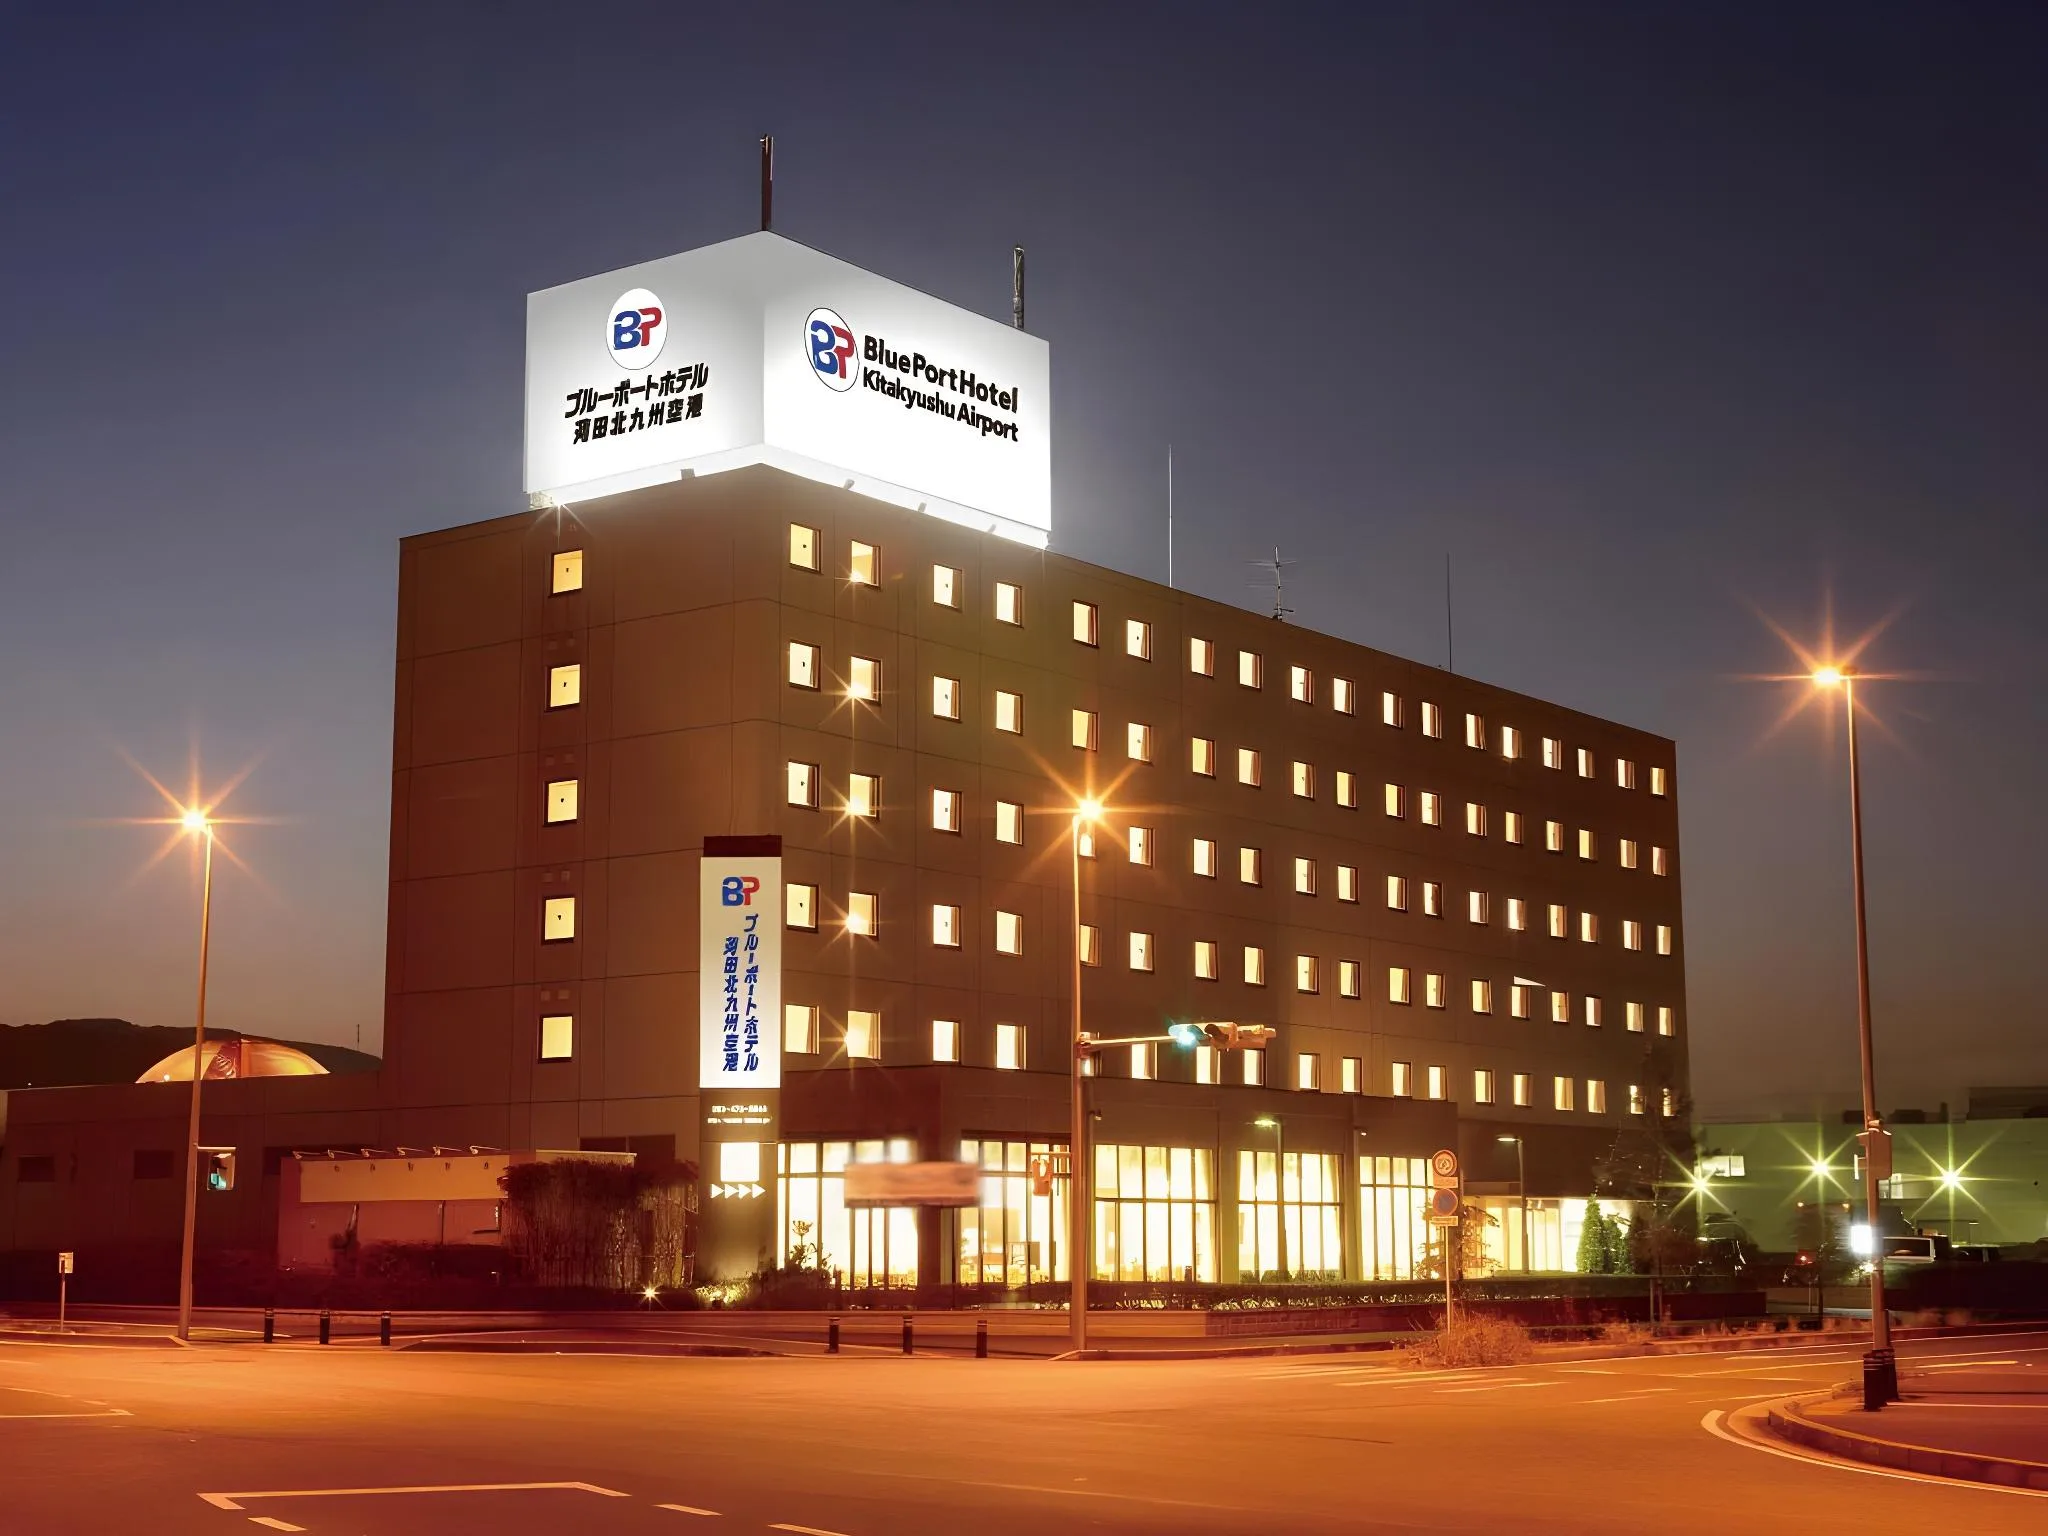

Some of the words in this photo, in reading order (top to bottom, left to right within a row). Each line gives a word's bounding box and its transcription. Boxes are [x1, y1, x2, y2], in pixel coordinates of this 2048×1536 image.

[613, 306, 662, 350] BP
[810, 319, 855, 379] BP
[564, 362, 709, 419] ブルーポートホテル
[863, 366, 956, 420] Kitakyushu
[956, 402, 1019, 442] Airport
[721, 876, 761, 907] BP
